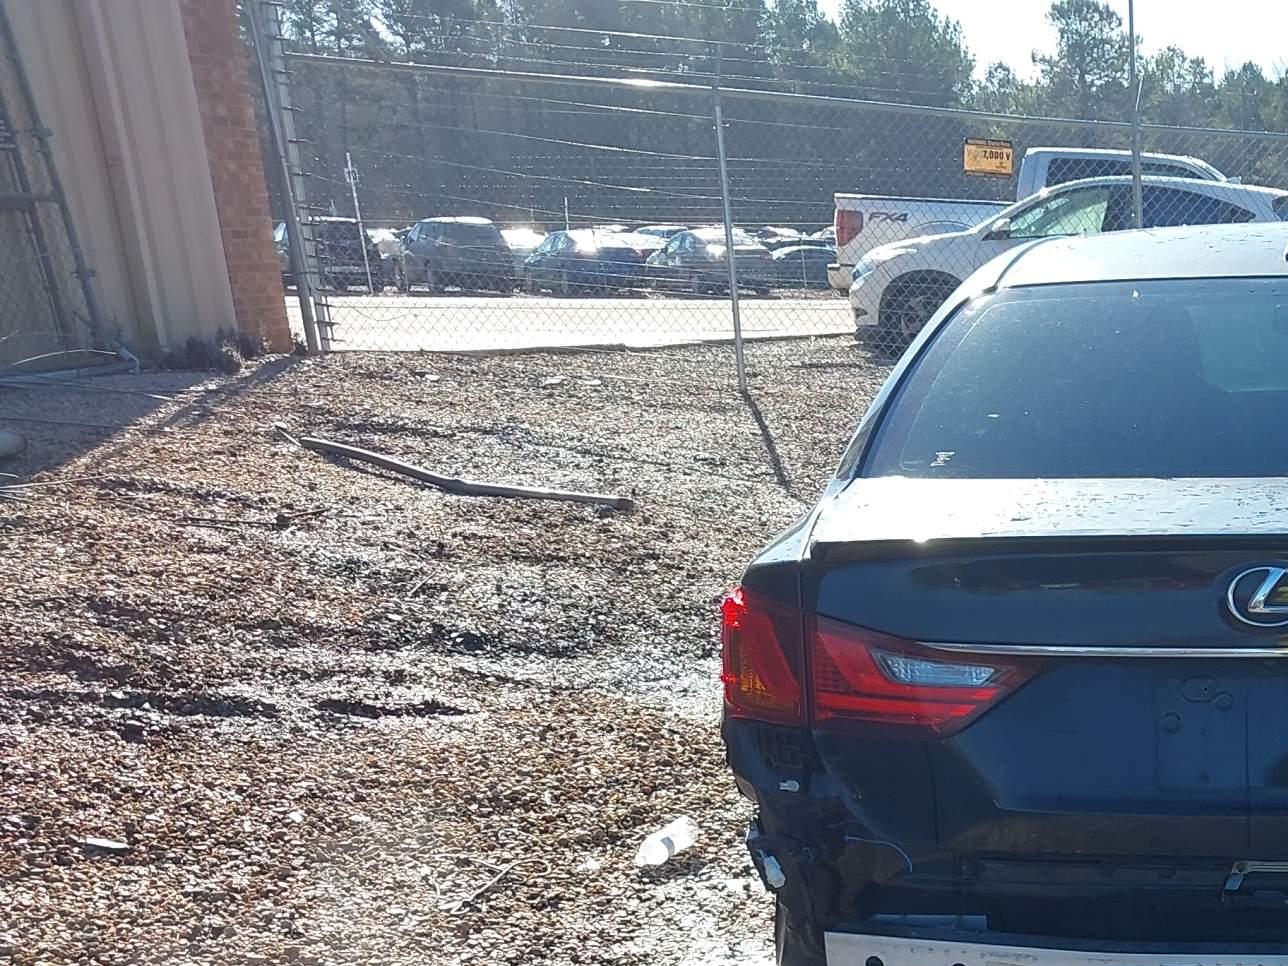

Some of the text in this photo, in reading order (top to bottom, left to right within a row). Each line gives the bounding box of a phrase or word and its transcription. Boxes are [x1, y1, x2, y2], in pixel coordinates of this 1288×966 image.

[983, 150, 1011, 160] 7,000 V
[869, 212, 909, 222] FX4
